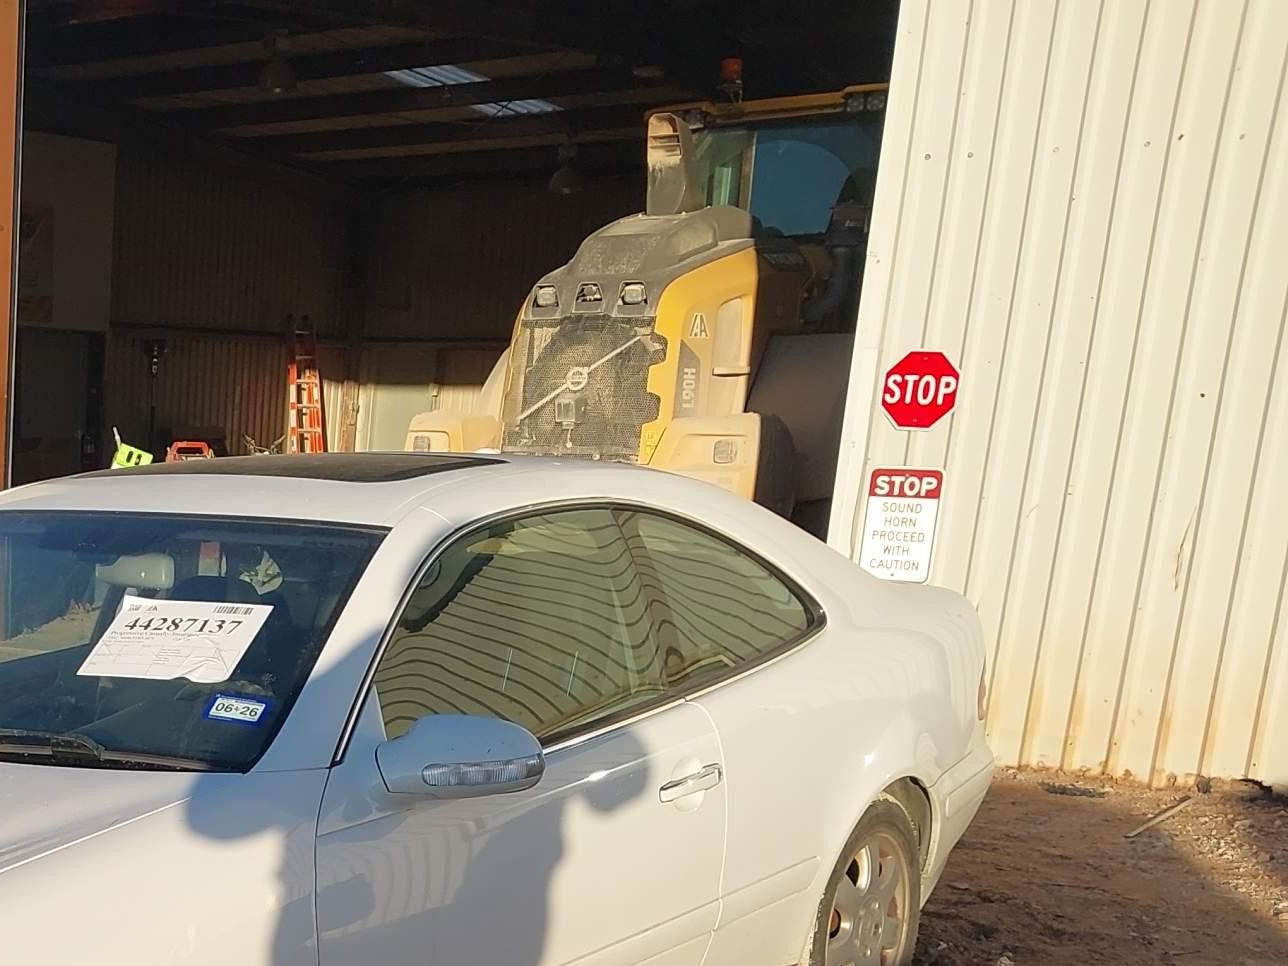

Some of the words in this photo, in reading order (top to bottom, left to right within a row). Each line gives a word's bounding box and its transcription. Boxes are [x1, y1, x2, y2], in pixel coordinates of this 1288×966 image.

[682, 367, 697, 409] L90H
[883, 373, 957, 406] STOP
[873, 475, 938, 497] STOP
[881, 501, 922, 514] SOUND
[883, 516, 917, 528] HORN
[871, 530, 925, 543] PROCEED
[882, 545, 910, 556] WITH
[869, 558, 920, 571] CAUTION
[124, 616, 244, 634] 44287137
[240, 706, 259, 717] 26
